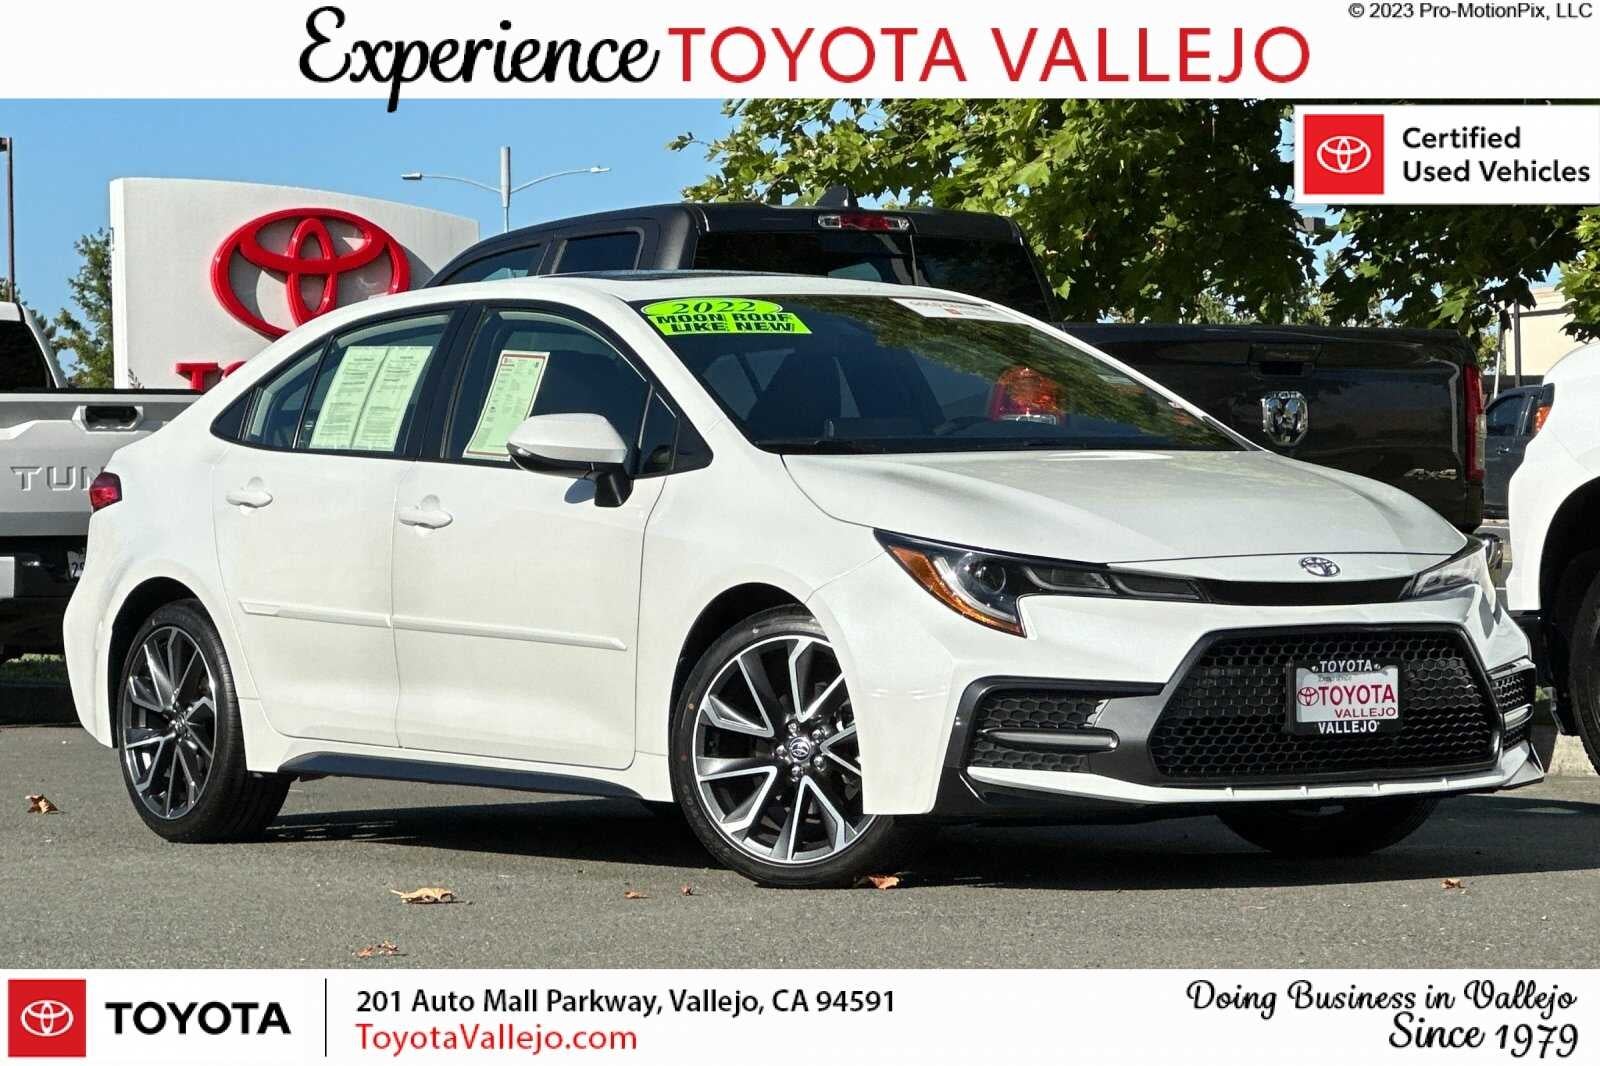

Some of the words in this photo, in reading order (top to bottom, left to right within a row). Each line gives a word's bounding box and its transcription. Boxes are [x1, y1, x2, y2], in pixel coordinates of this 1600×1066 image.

[672, 302, 756, 313] 2022
[656, 313, 725, 323] MOON
[732, 313, 792, 322] ROOF
[671, 322, 727, 332] LIKE
[735, 322, 795, 332] NEW
[1319, 660, 1373, 673] TOYOTA
[1318, 684, 1396, 706] TOYOTA
[1334, 706, 1397, 718] VALLEJO
[1318, 720, 1378, 734] VALLEJO
